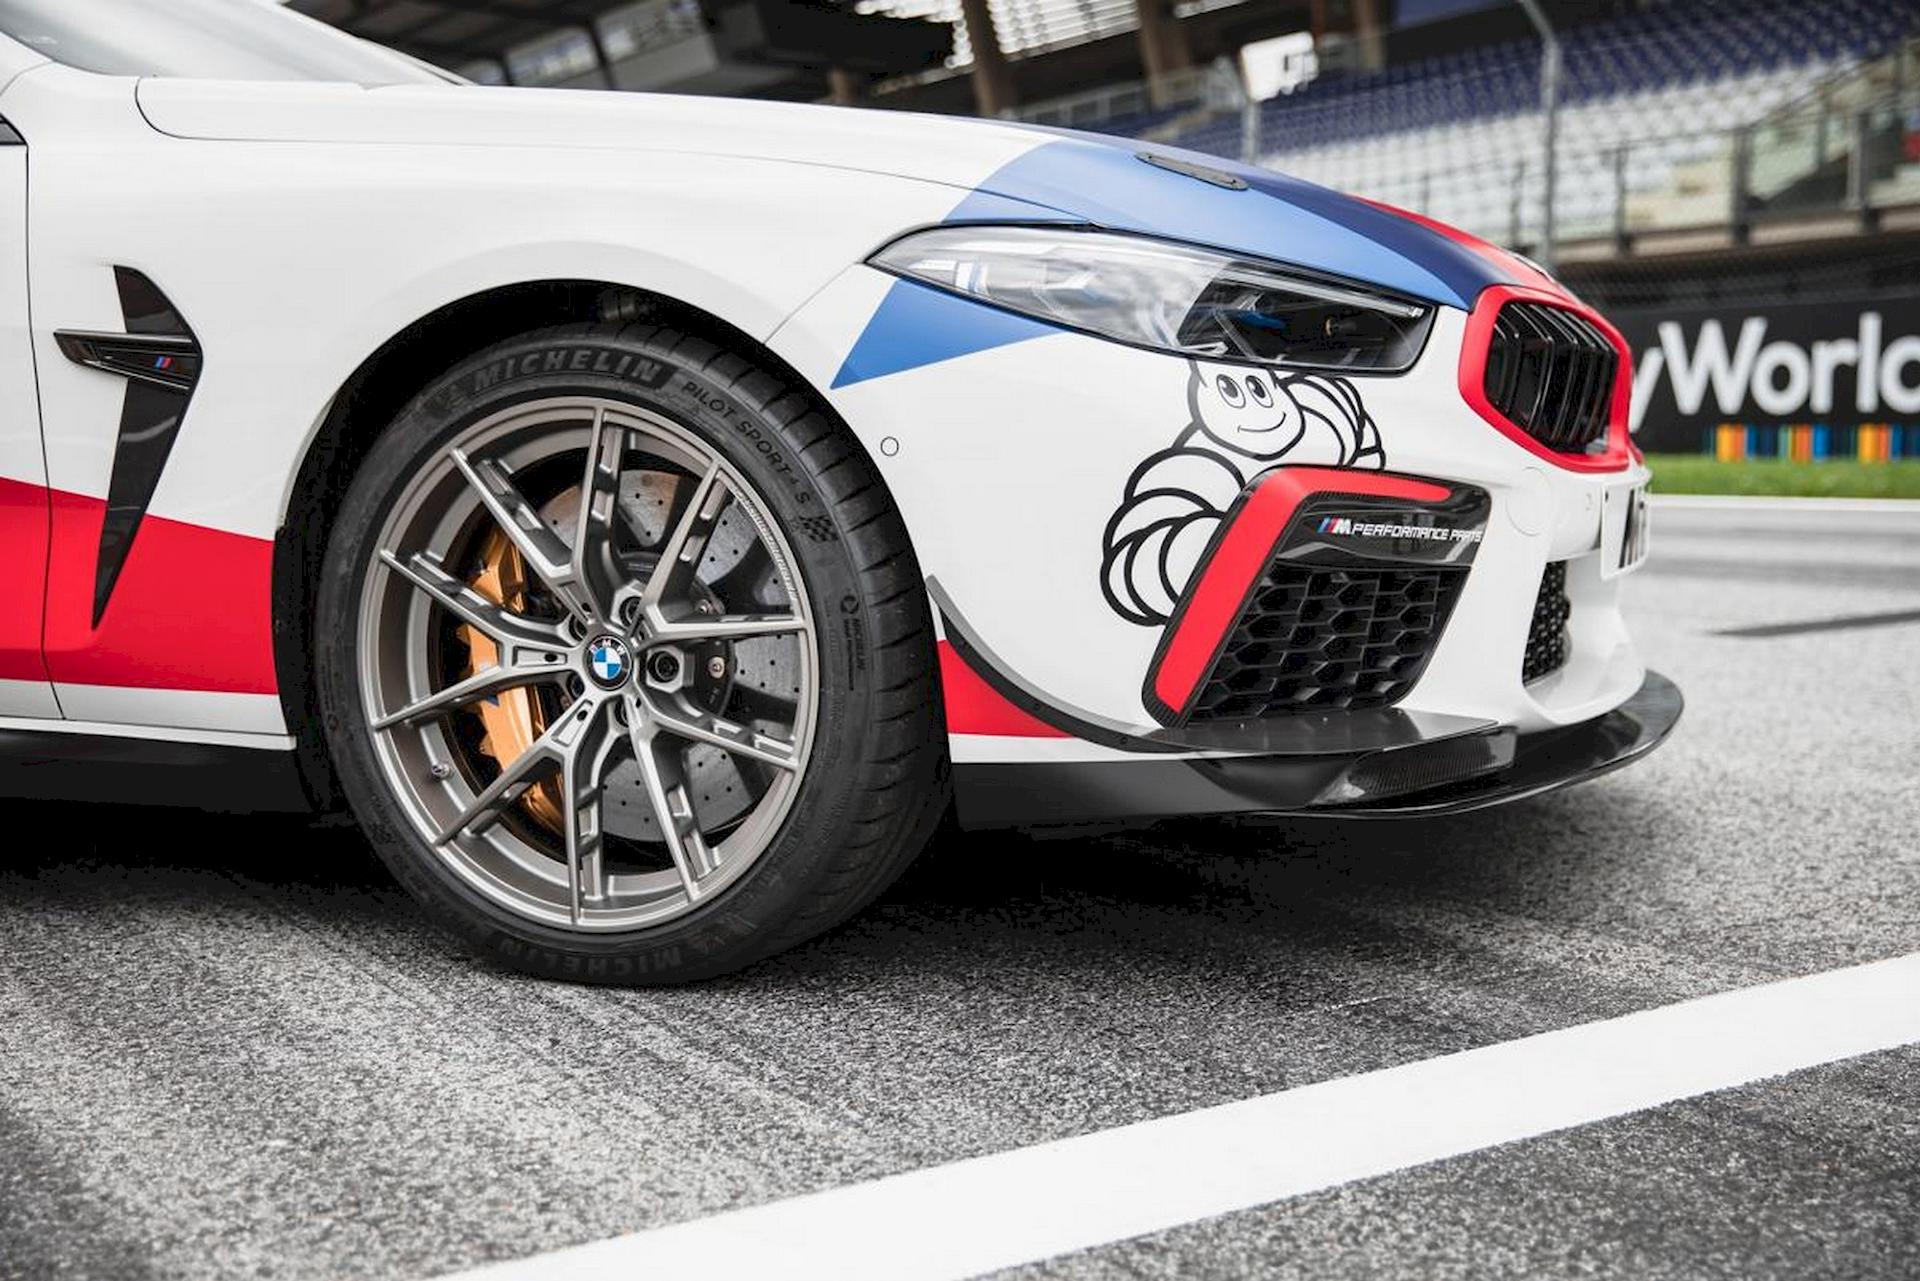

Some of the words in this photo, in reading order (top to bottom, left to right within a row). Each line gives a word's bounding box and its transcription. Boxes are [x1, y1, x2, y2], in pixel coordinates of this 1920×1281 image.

[473, 349, 662, 387] MICHELIN
[681, 381, 736, 418] PILOT
[736, 421, 792, 473] SPORT
[1351, 523, 1448, 539] PERFORMANCE
[1449, 529, 1483, 543] PARTS
[502, 939, 684, 976] MICHELIN
